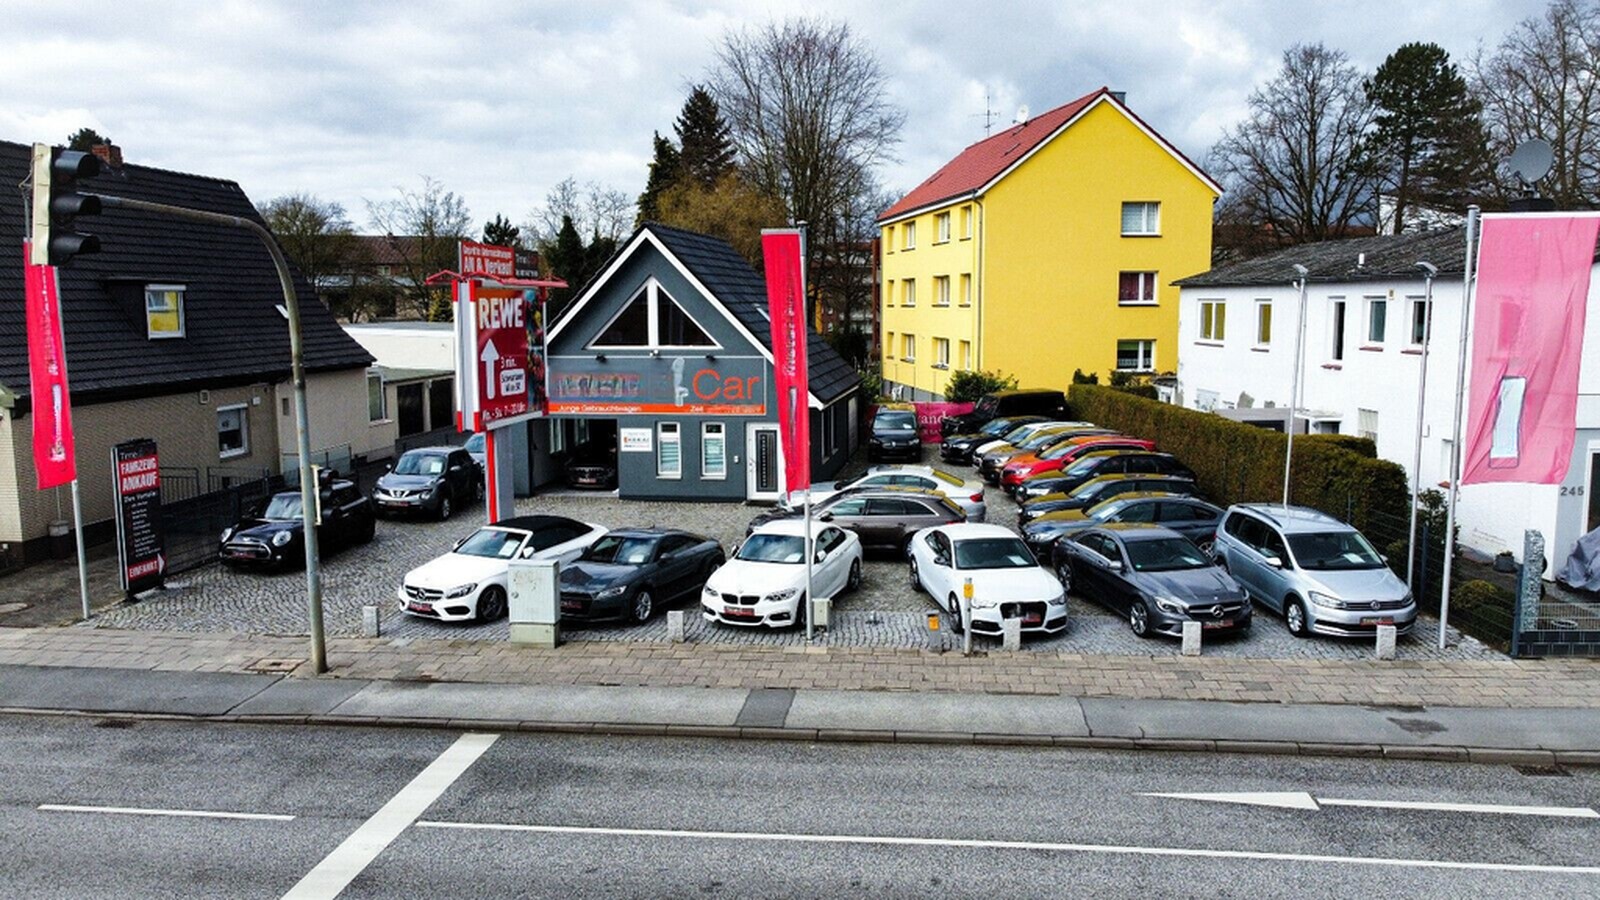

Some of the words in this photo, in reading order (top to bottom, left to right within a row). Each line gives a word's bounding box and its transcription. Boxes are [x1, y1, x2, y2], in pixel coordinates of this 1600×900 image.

[478, 297, 524, 330] REWE
[692, 368, 760, 400] Car
[558, 404, 580, 414] Junge
[581, 403, 642, 414] Gebrauchtwagen
[120, 457, 156, 475] FAHRZEUG
[122, 471, 157, 491] ANKAUF
[1560, 485, 1585, 496] 245
[129, 560, 158, 578] EINFAHRT
